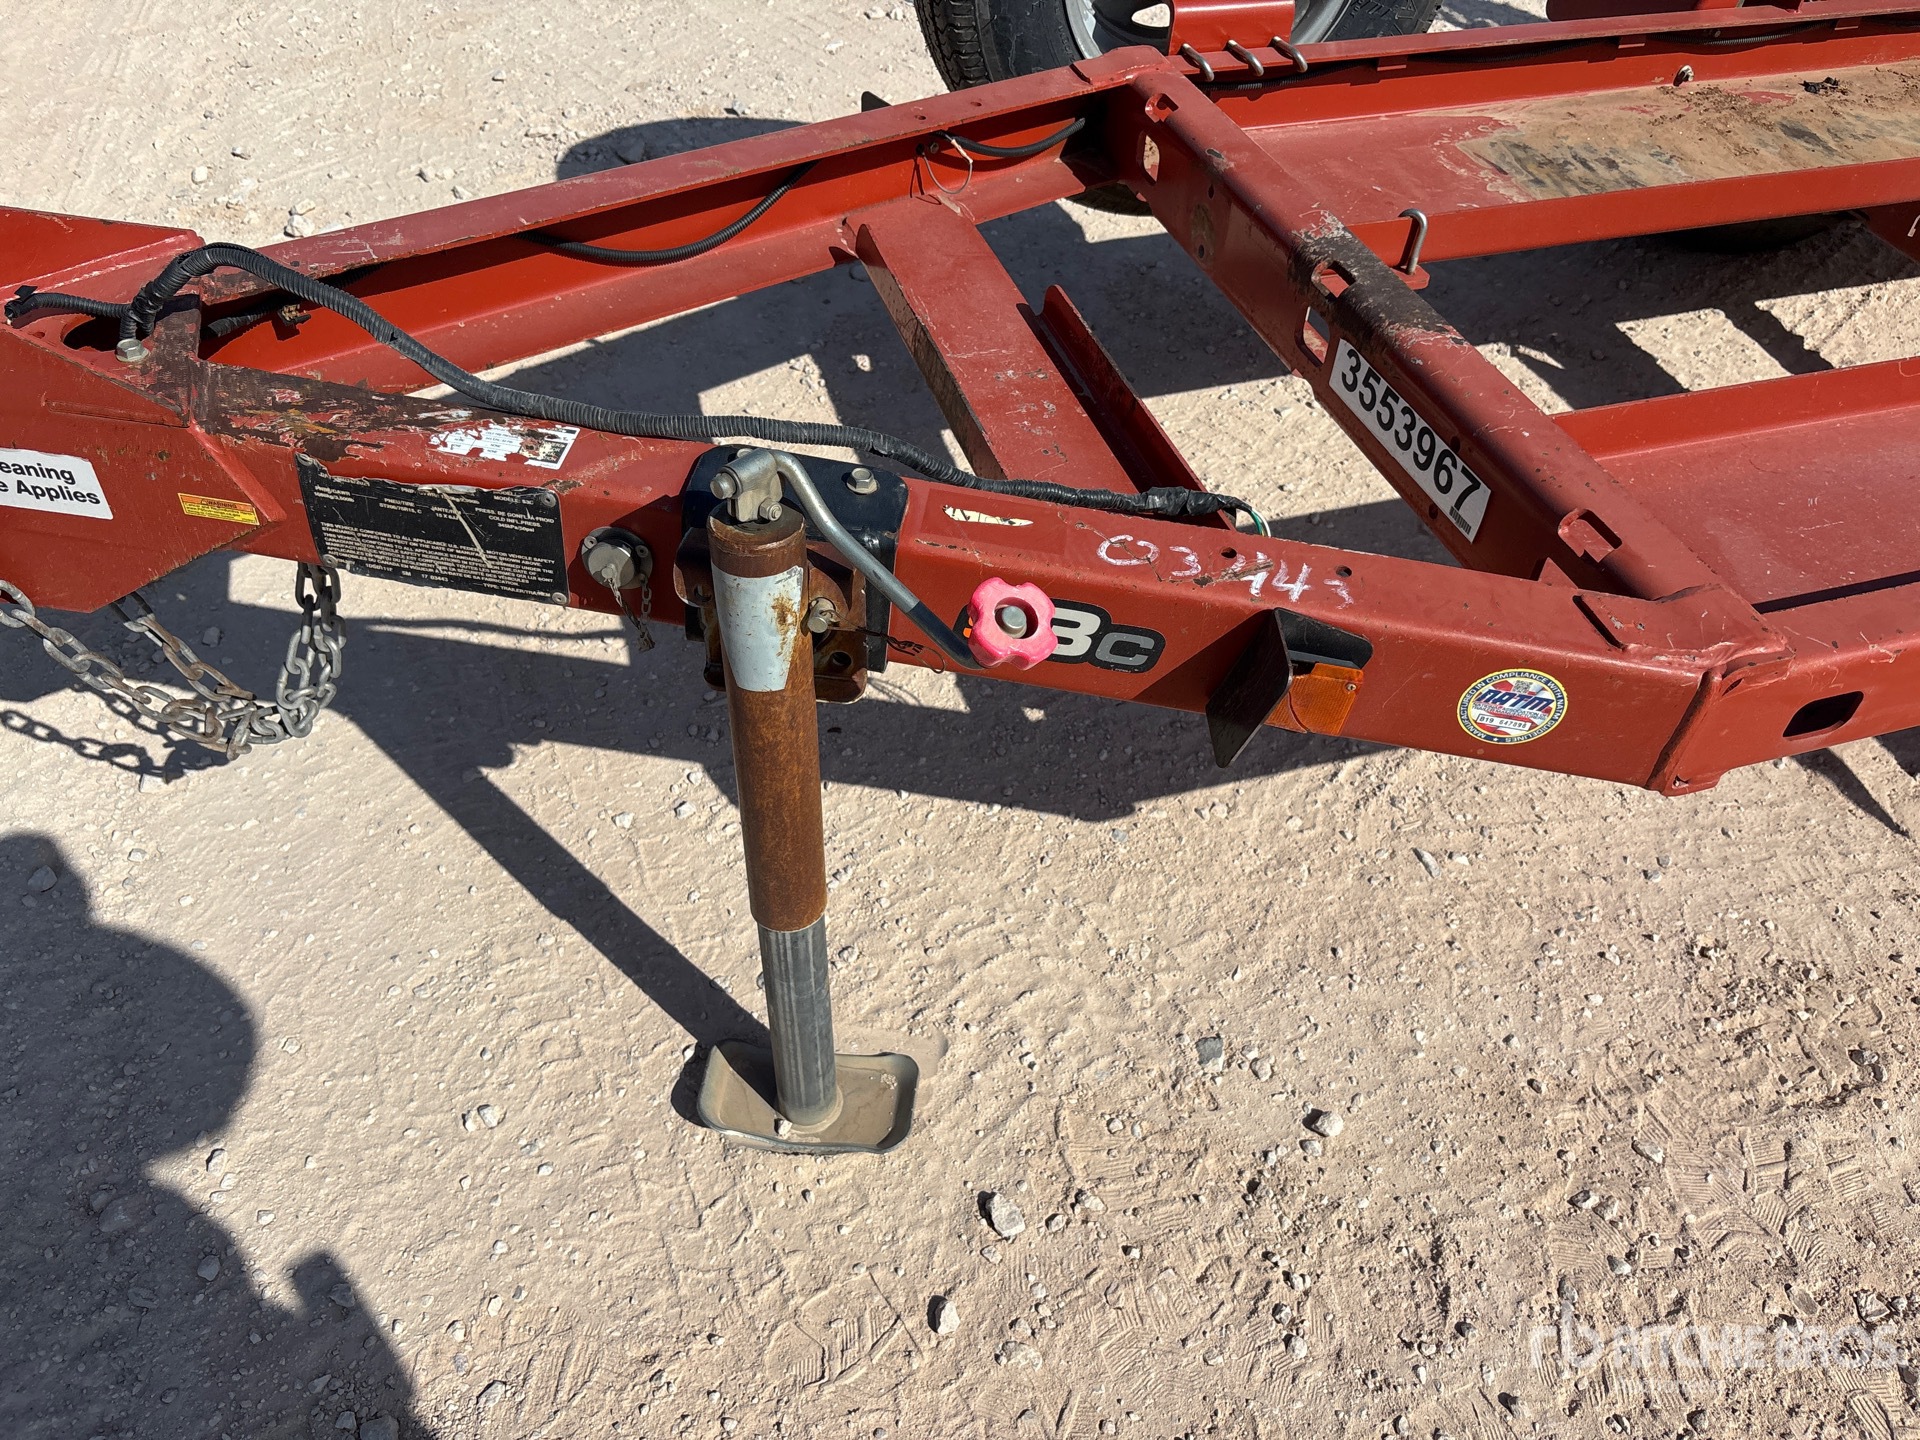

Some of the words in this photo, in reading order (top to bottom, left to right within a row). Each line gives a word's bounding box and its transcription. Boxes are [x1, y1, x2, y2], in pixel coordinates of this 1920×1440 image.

[1341, 349, 1481, 511] 3553967
[0, 461, 76, 485] eaning
[17, 480, 101, 505] Applies
[1475, 681, 1485, 692] IN
[1486, 671, 1549, 684] COMPLIANCE
[1547, 682, 1564, 700] WITH
[1461, 689, 1487, 739] MANUFACTURED
[1505, 719, 1556, 743] GUIDELINES
